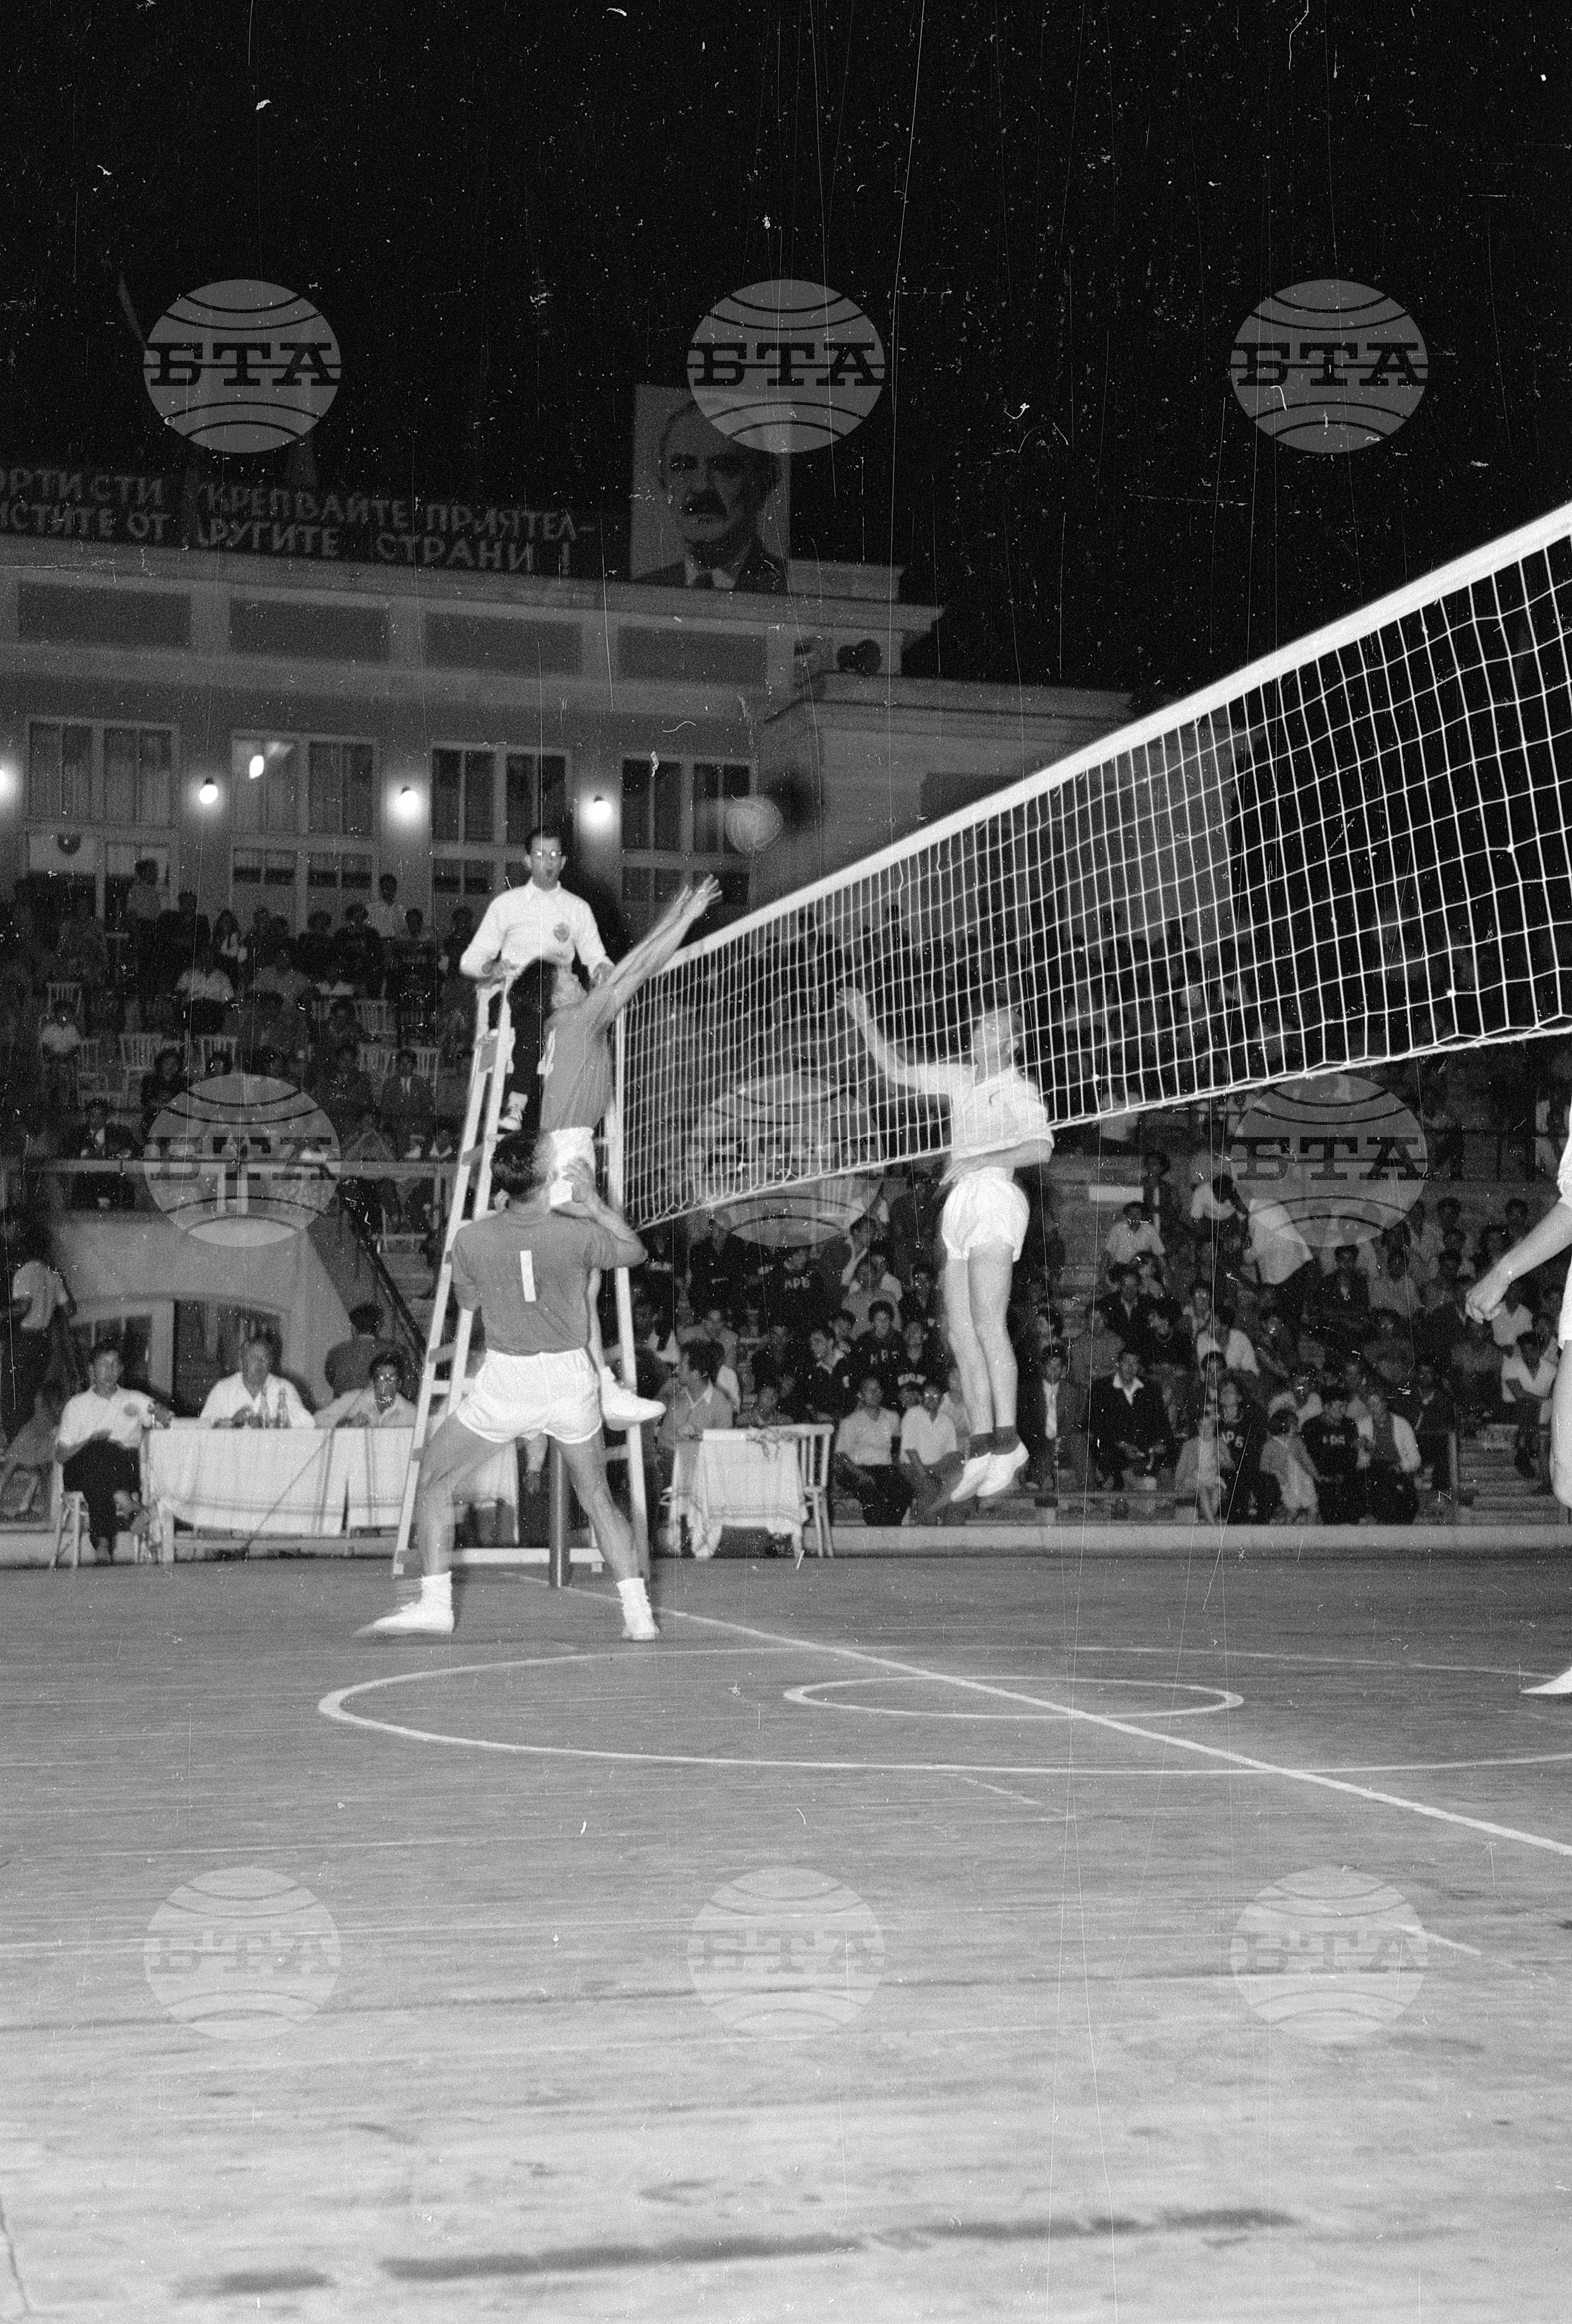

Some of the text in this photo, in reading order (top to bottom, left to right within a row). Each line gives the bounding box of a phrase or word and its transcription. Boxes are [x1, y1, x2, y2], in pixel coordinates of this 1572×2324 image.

[0, 467, 163, 505] РТИСТИ
[198, 481, 407, 526] КРЕПВАЙТЕ
[127, 512, 171, 541] ОТ
[375, 532, 534, 573] СТРАНИ
[520, 1250, 536, 1302] 1
